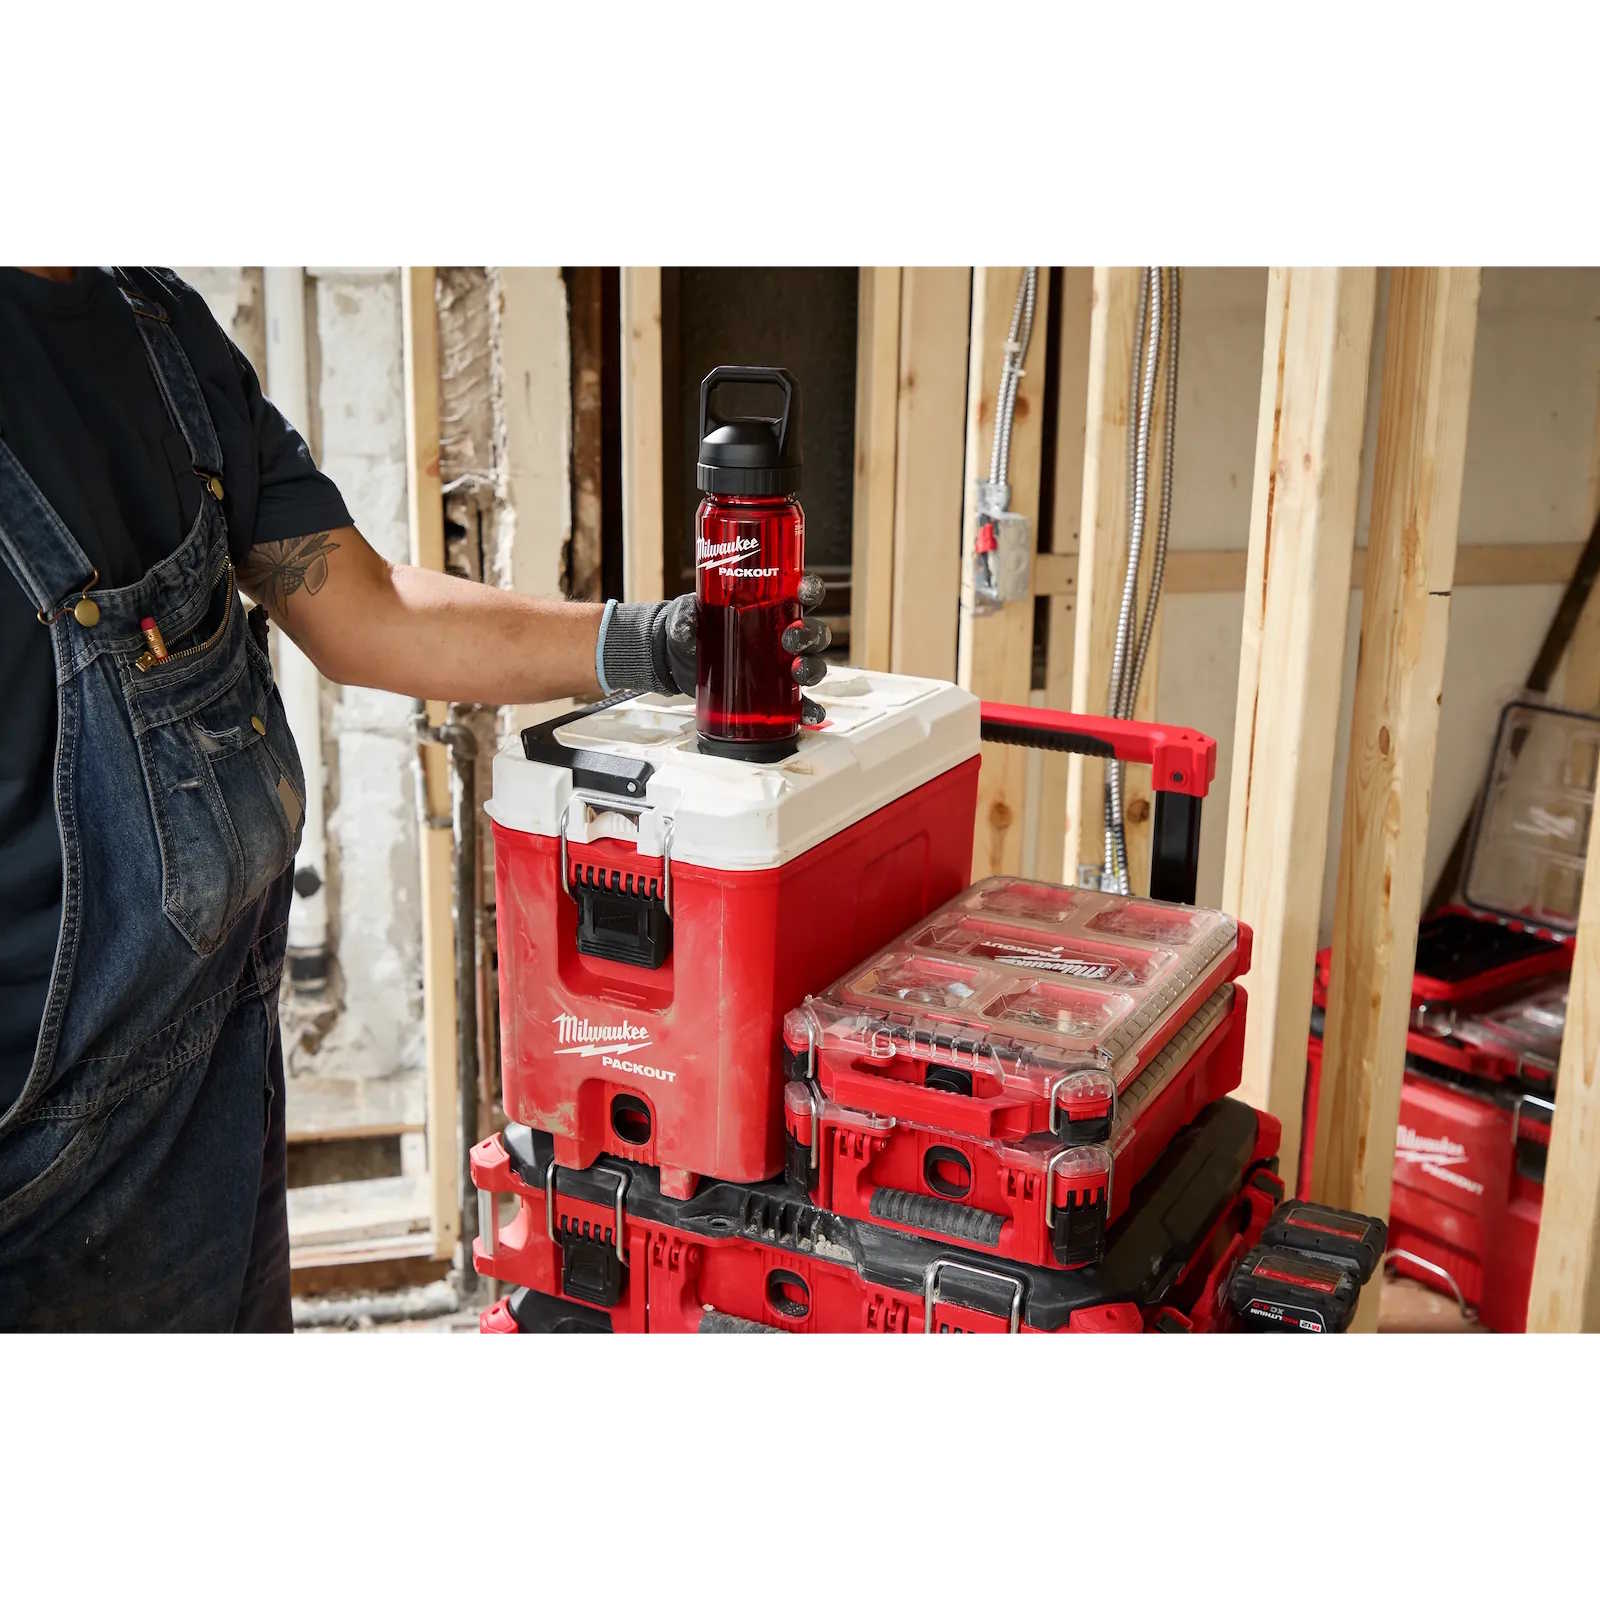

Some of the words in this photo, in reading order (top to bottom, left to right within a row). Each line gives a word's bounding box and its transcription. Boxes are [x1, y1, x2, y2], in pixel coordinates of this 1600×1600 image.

[696, 536, 760, 560] Milwaukee
[719, 567, 779, 578] PACKOUT
[980, 941, 1062, 959] PACKOUT
[552, 1012, 650, 1044] Milwaukee
[602, 1055, 677, 1082] PACKOUT
